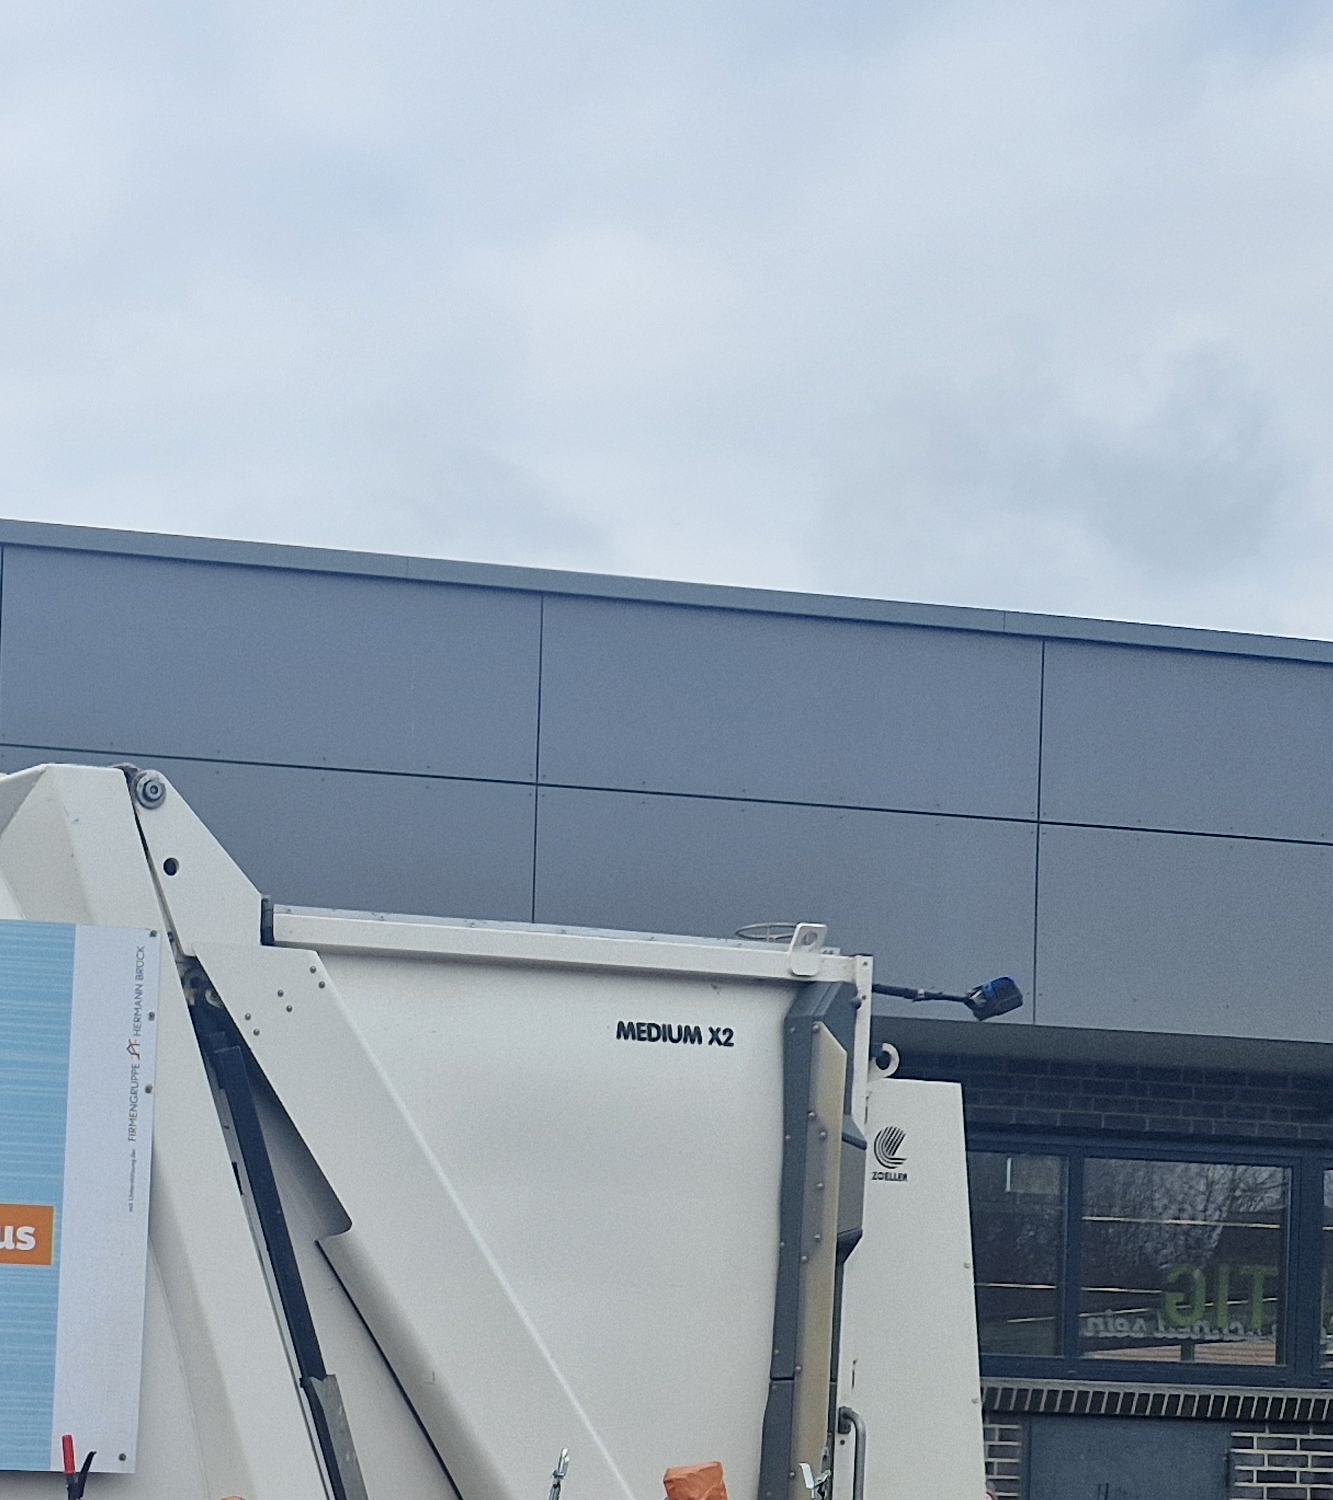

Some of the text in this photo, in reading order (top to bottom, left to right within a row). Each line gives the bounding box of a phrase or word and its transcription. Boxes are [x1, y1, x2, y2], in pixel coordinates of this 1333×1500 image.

[133, 984, 144, 1037] HERMANN
[616, 1020, 735, 1047] MEDIUM X2
[127, 1063, 140, 1142] FIRMENGRUPPE
[871, 1171, 908, 1181] ZOELLER
